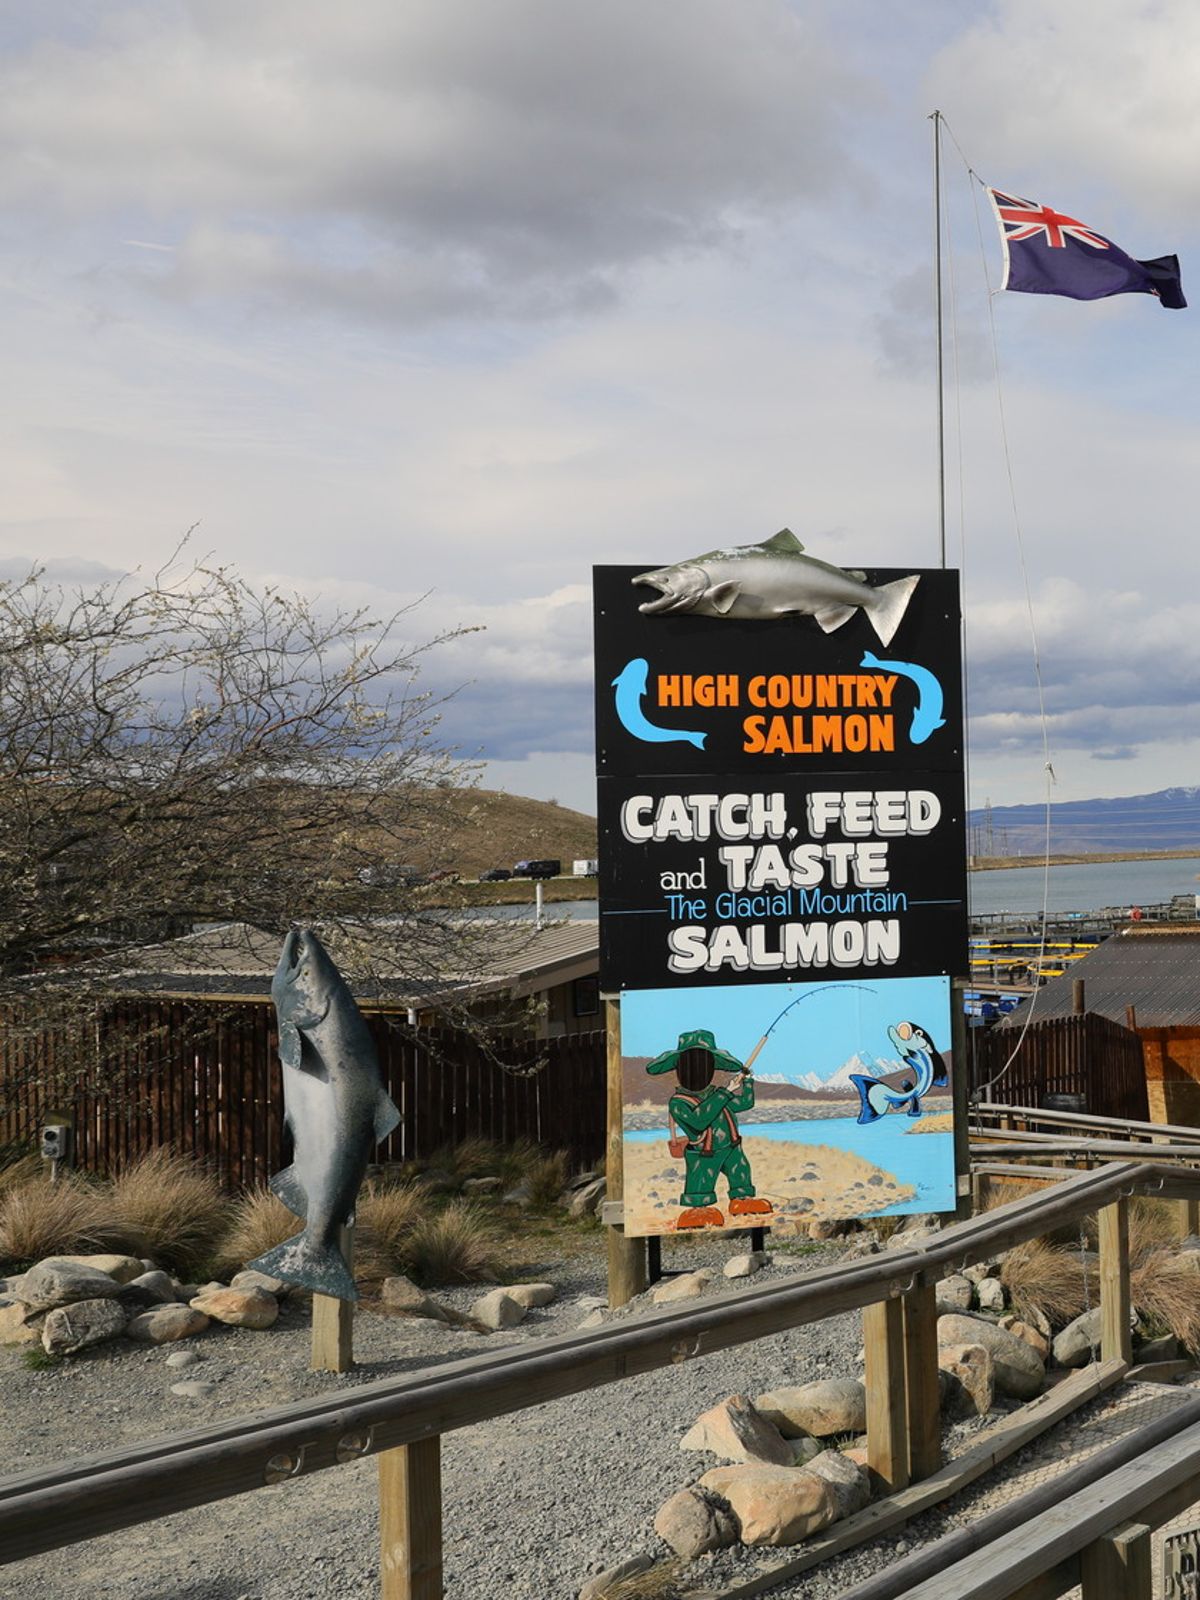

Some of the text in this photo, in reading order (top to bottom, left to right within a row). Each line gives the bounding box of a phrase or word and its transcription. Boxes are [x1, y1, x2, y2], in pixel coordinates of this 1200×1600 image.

[658, 675, 898, 708] HIGH COUNTRY
[743, 715, 895, 753] SALMON
[621, 791, 942, 843] CATCH, FEED
[660, 842, 890, 890] and TASTE
[666, 888, 907, 920] The Glacial Mountain
[668, 919, 901, 973] SALMON
